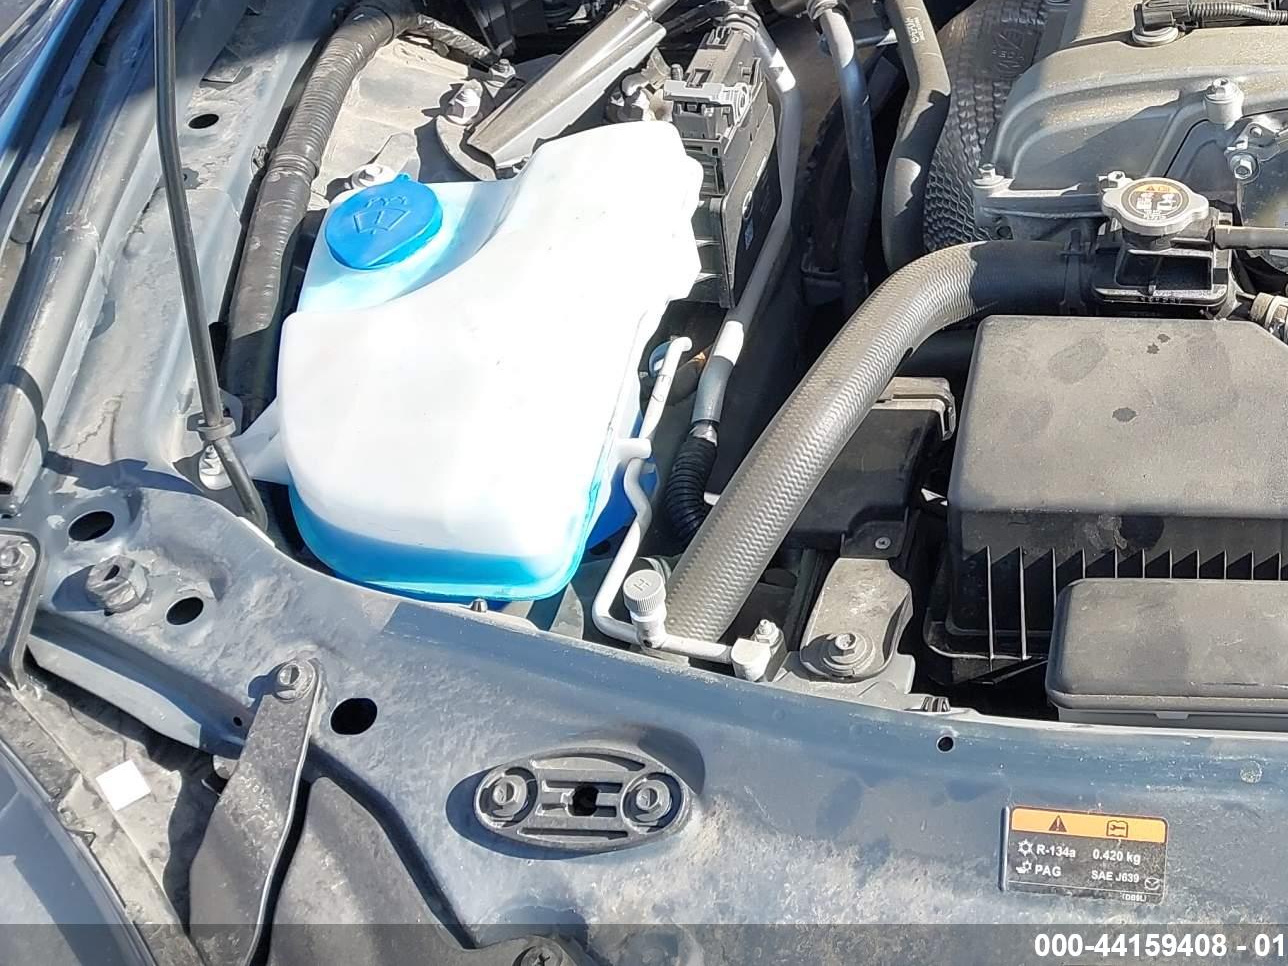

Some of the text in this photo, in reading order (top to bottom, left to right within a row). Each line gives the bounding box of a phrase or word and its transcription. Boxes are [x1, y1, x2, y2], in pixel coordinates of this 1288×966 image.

[1036, 843, 1142, 865] R-134a 0.420 kg
[1034, 864, 1140, 883] PAG SAE J639
